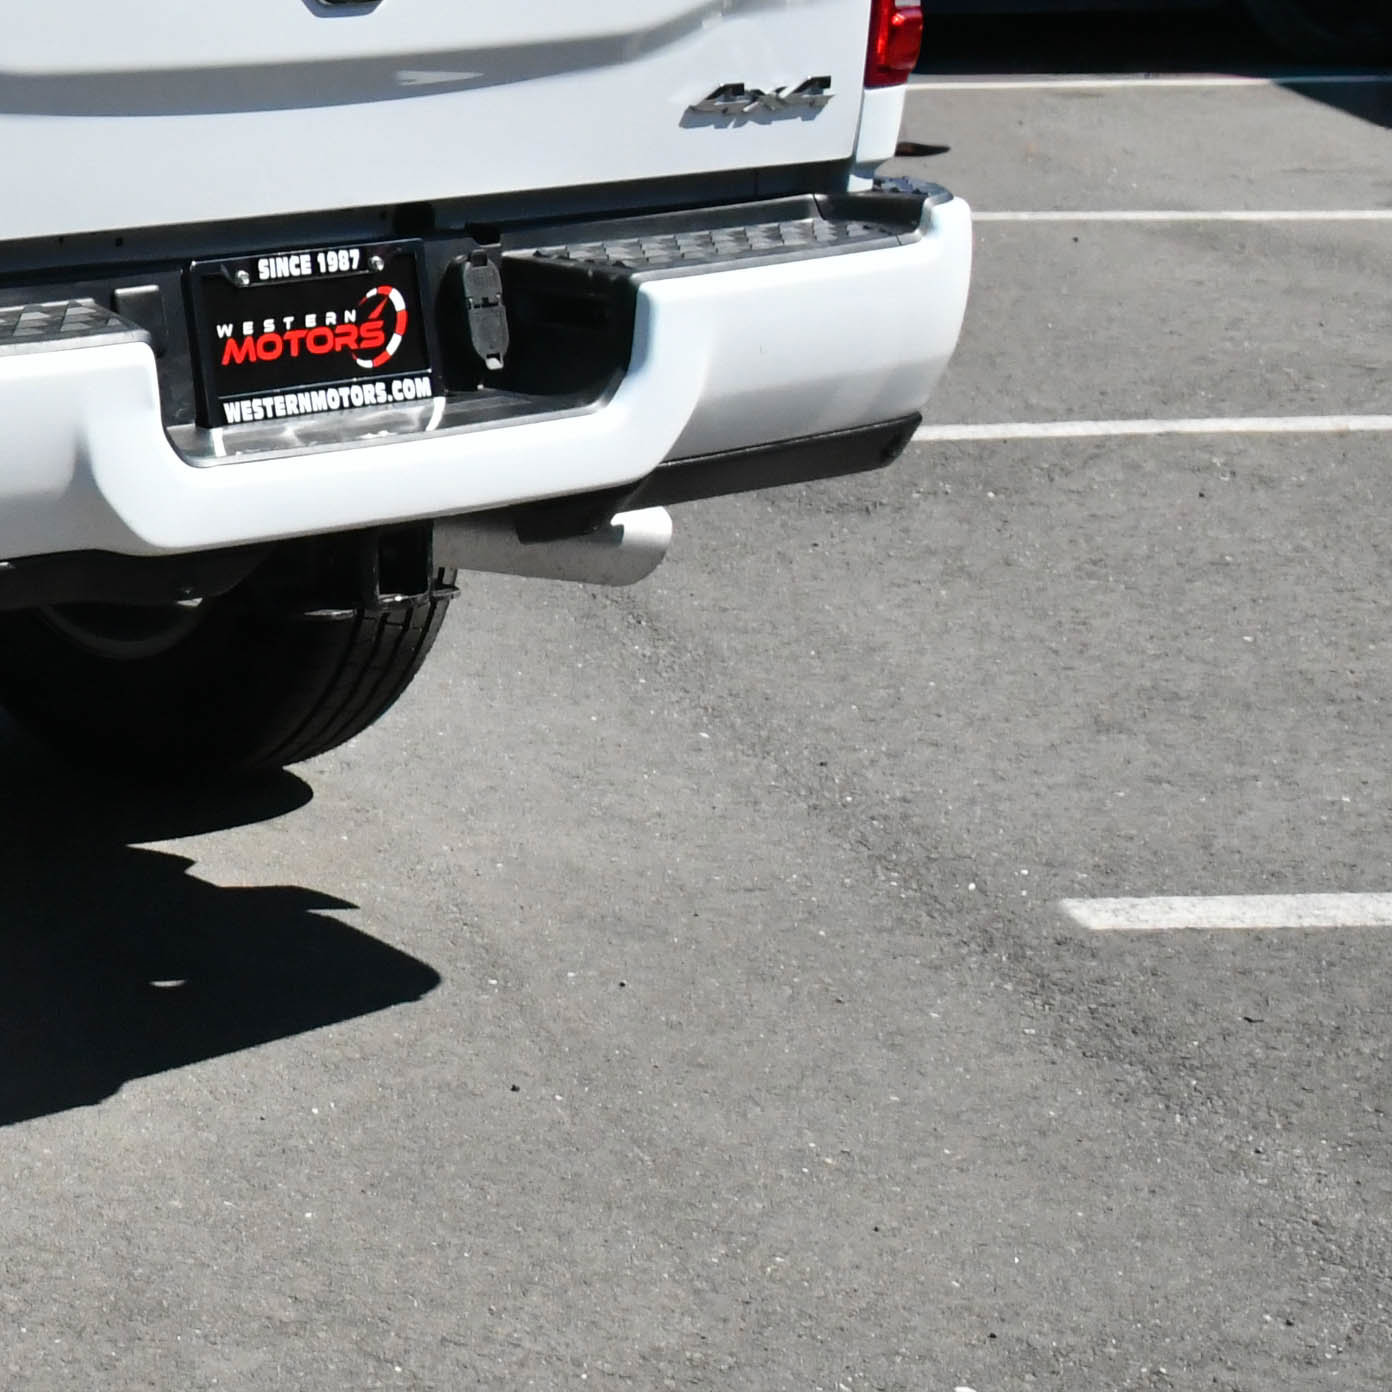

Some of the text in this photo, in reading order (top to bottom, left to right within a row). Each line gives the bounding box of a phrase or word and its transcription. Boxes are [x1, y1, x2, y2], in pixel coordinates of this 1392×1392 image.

[257, 248, 361, 281] SINCE 1987
[216, 309, 357, 338] WESTERN
[221, 319, 385, 366] MOTORS
[223, 376, 432, 424] WESTERNMOTORS.COM
